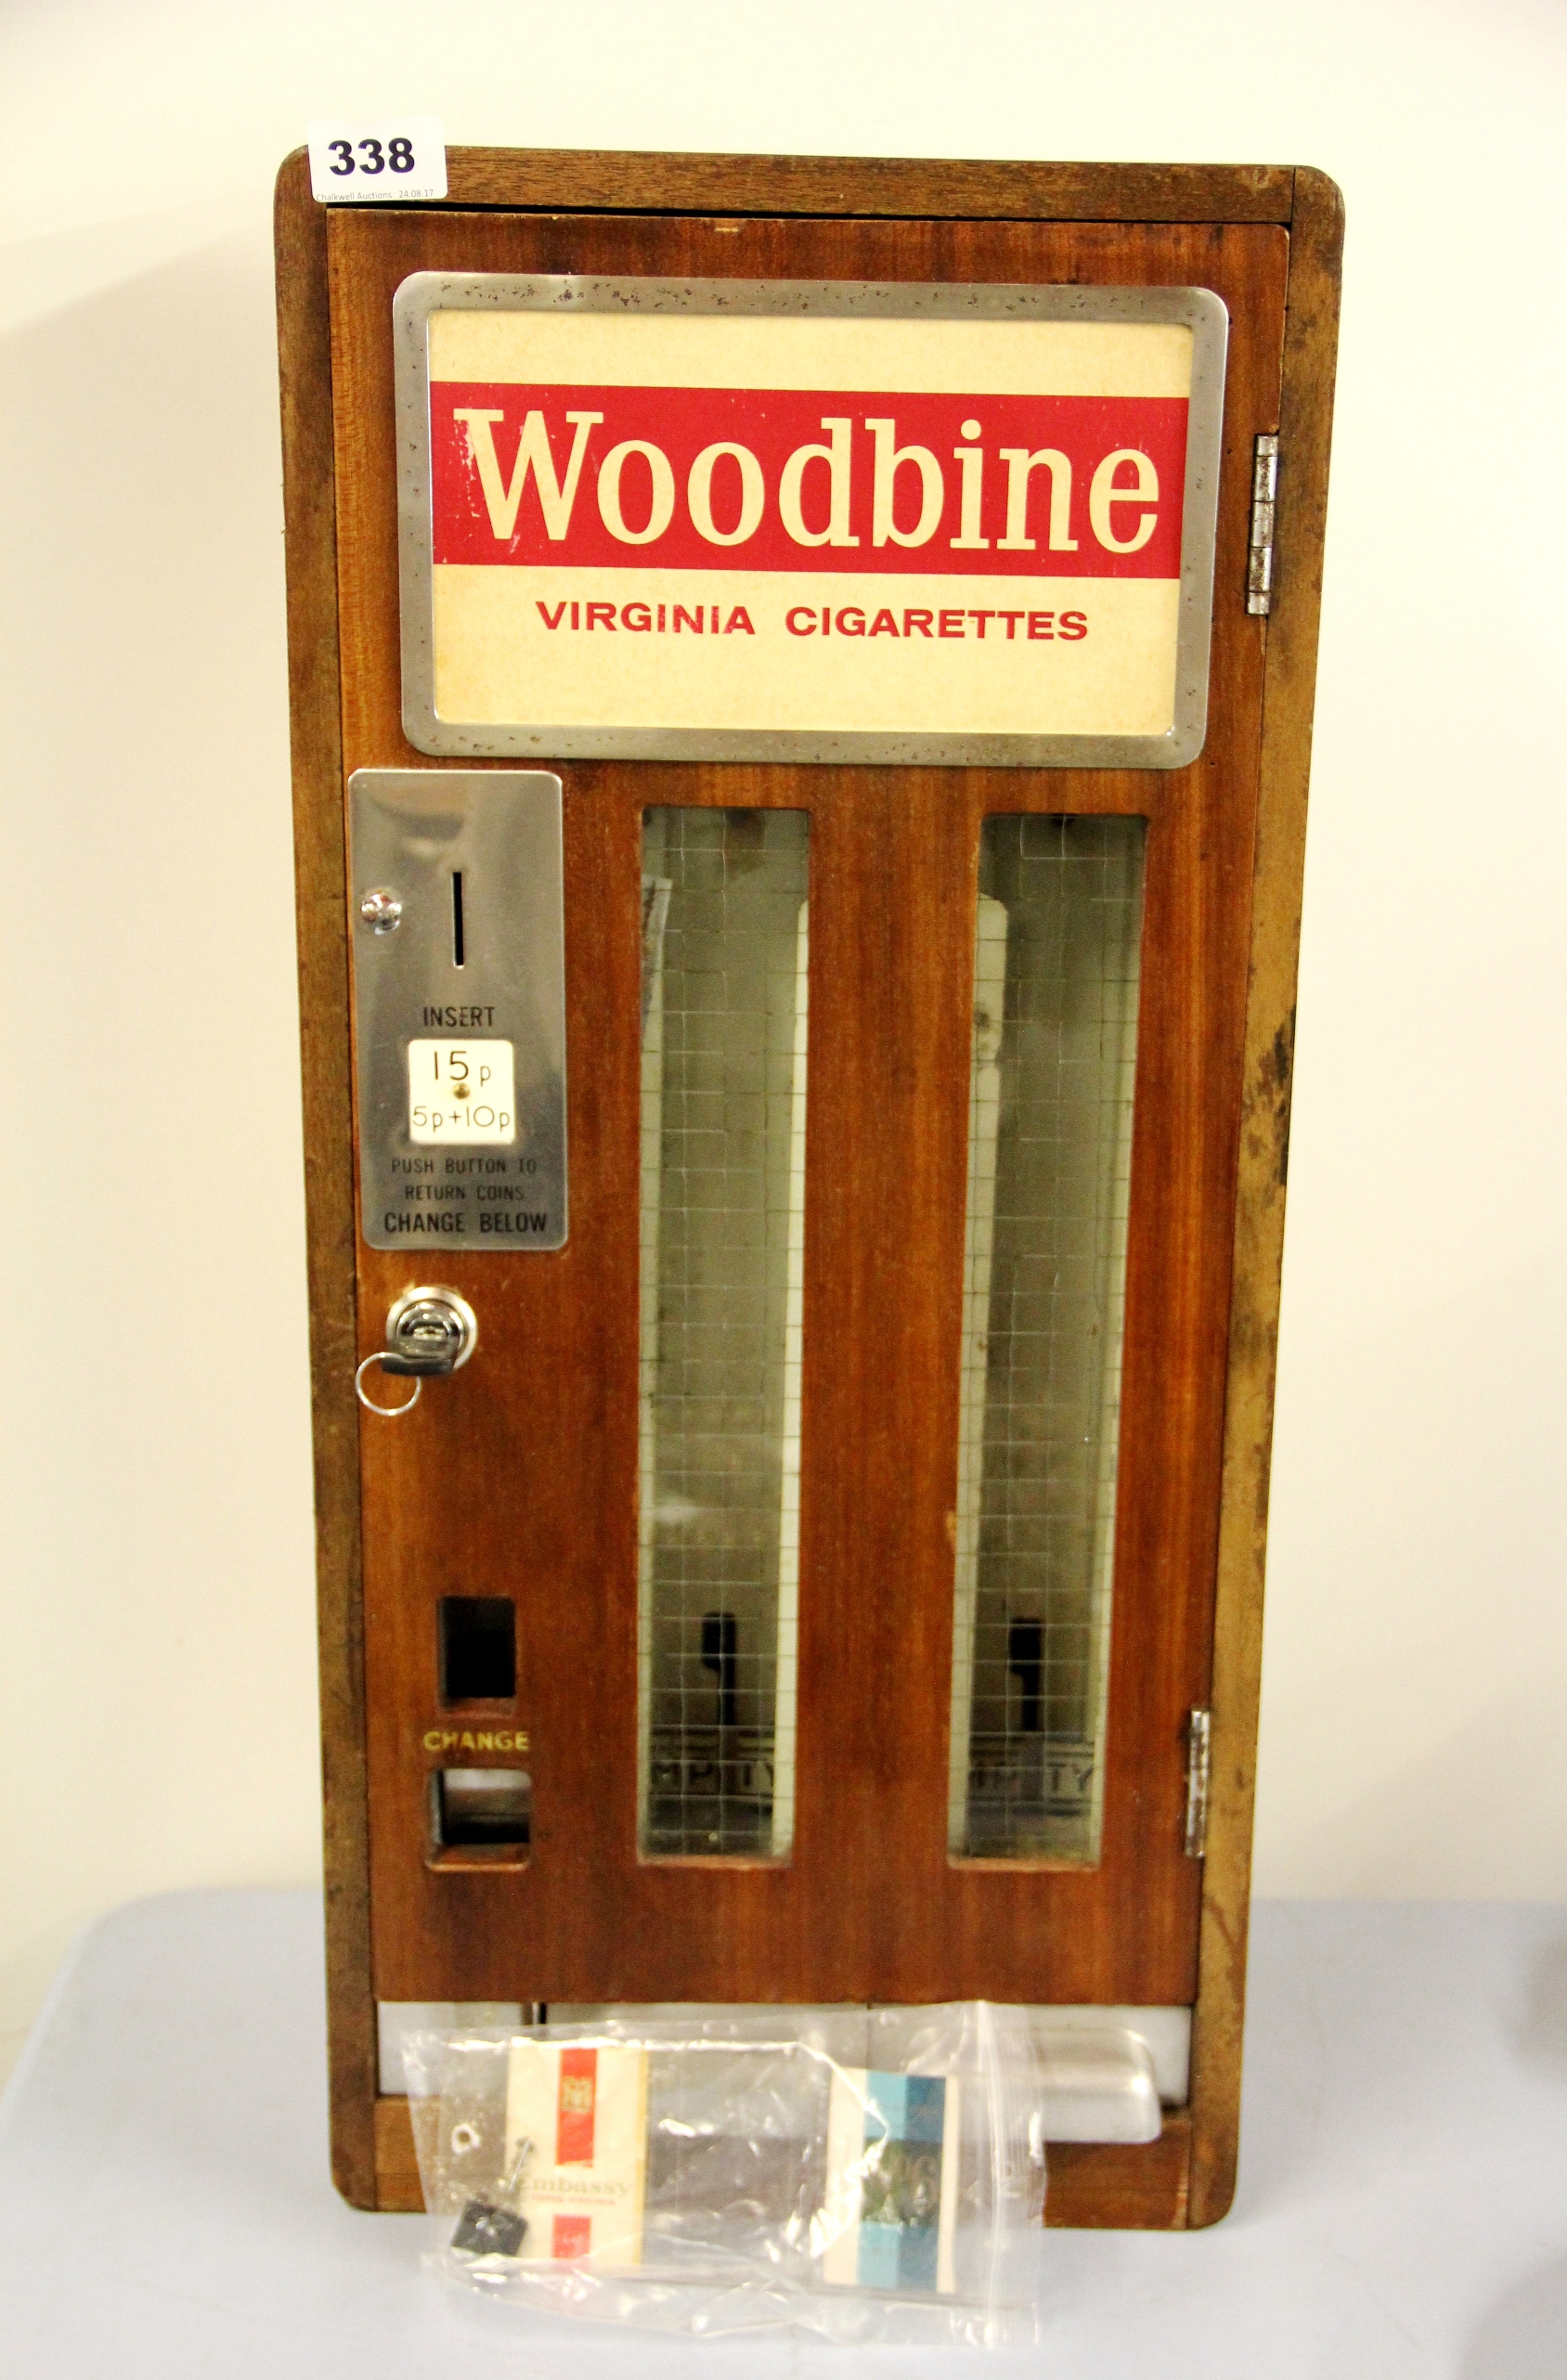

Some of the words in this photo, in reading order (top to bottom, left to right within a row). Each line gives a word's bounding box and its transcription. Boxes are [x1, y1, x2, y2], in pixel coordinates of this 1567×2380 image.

[328, 137, 415, 175] 338
[316, 192, 355, 201] Chalkwell
[356, 191, 392, 200] Auctions
[398, 188, 434, 198] 24.08.17
[453, 407, 1160, 554] Woodbine
[536, 601, 756, 635] VIRGINIA
[785, 605, 1088, 641] CIGARETTES
[423, 1006, 495, 1027] INSERT
[391, 1158, 434, 1173] PUSH
[445, 1158, 506, 1174] BUTTON
[519, 1158, 537, 1174] TO
[405, 1184, 465, 1200] RETURN
[476, 1184, 524, 1201] COINS
[383, 1212, 464, 1233] CHANGE
[480, 1212, 548, 1233] BELOW
[423, 1730, 530, 1752] CHANGE
